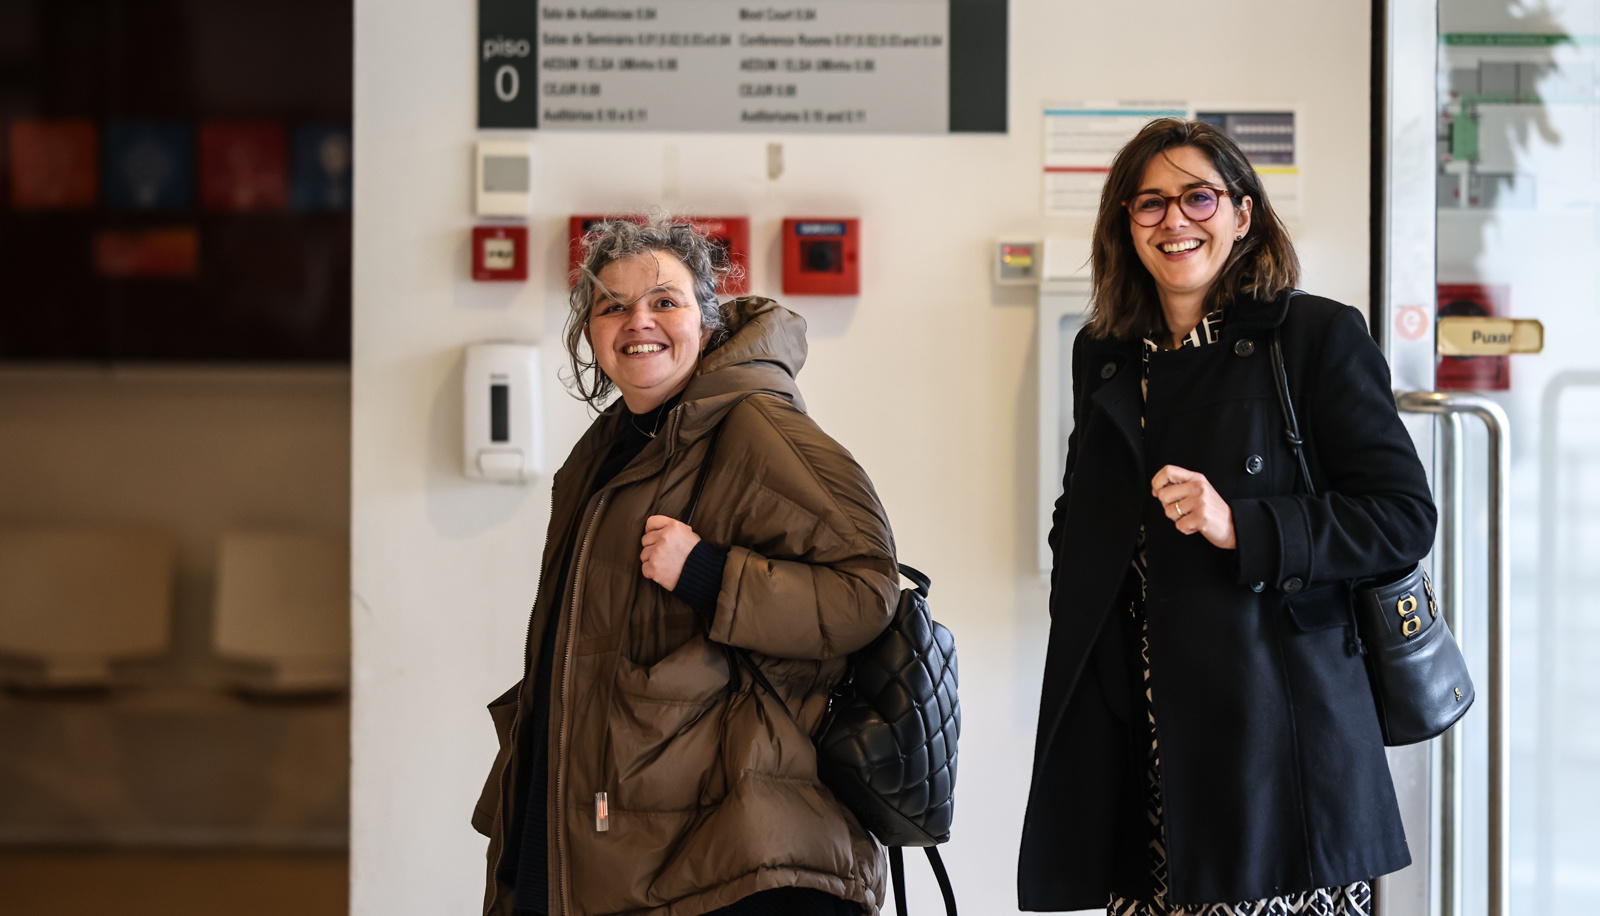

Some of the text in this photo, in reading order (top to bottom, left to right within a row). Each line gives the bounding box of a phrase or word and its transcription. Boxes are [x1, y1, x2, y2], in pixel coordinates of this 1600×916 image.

[541, 7, 563, 20] Sala
[565, 7, 578, 20] de
[739, 8, 764, 20] Moot
[766, 8, 794, 20] Court
[541, 33, 568, 46] Salas
[570, 33, 583, 46] de
[739, 34, 796, 47] Conference
[798, 34, 832, 46] Rooms
[484, 36, 530, 60] piso
[496, 65, 519, 101] 0
[1471, 329, 1514, 344] Puxar
